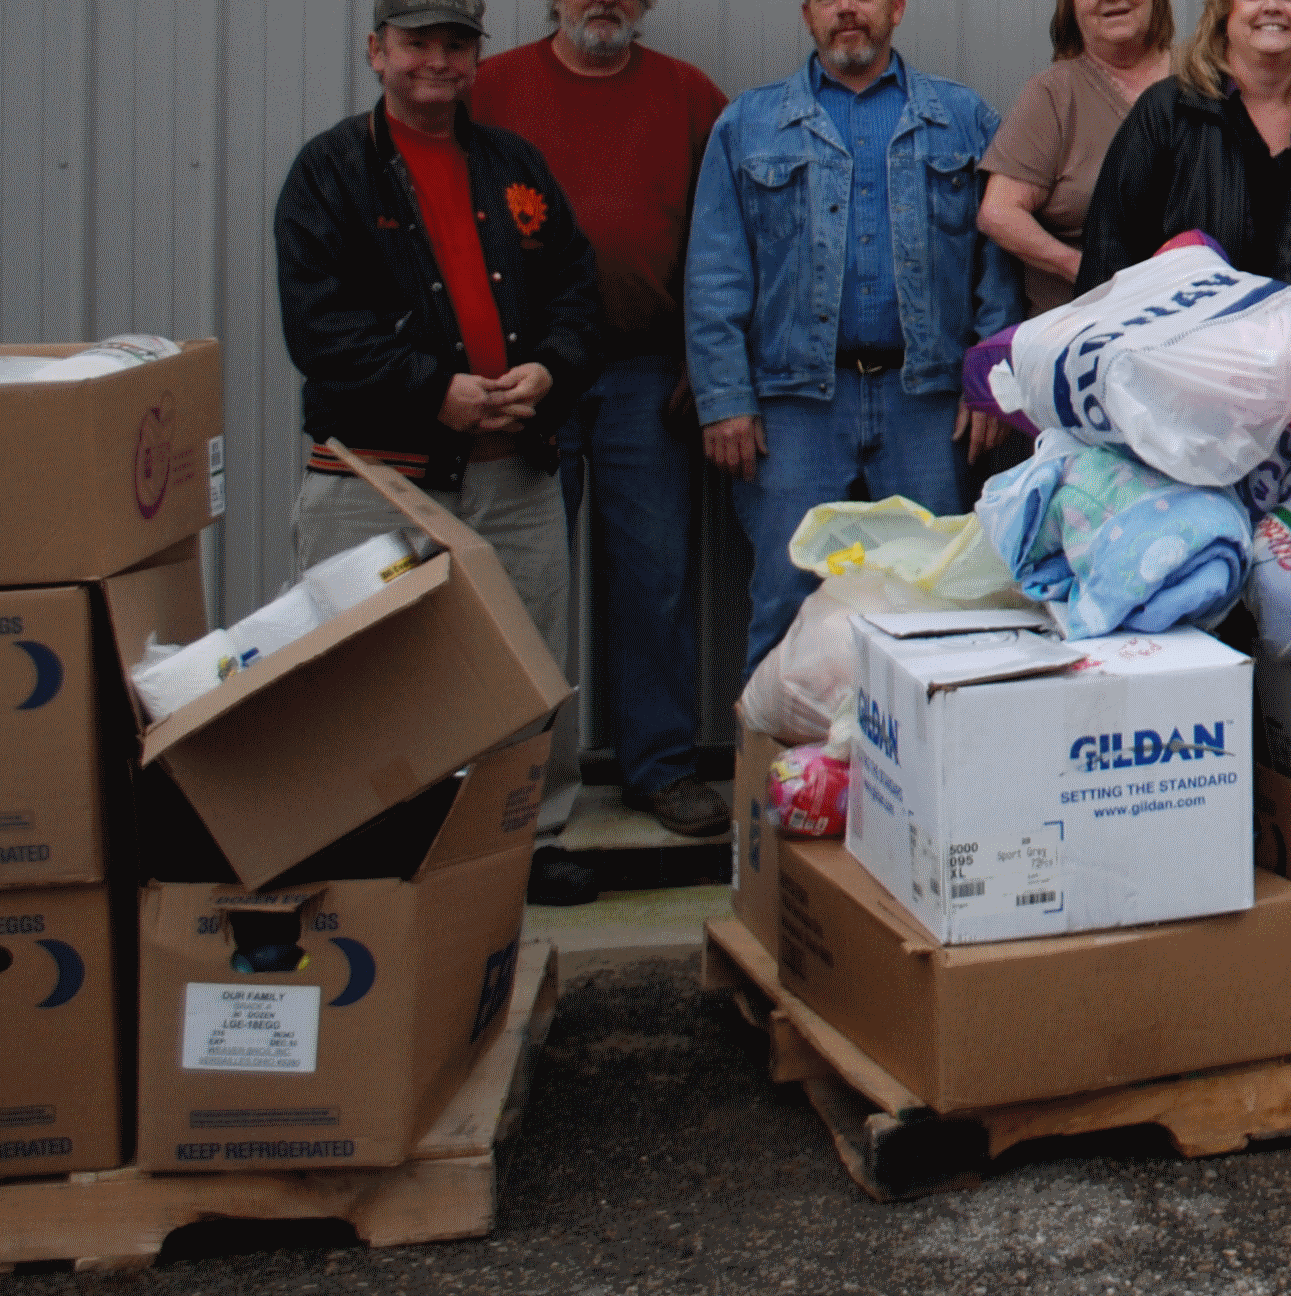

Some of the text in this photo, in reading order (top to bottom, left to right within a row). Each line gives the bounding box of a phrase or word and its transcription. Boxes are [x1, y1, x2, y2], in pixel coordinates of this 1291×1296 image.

[1069, 721, 1226, 773] GILDAN
[1060, 771, 1238, 805] SETTING THE STANDARD
[1094, 794, 1206, 818] www.gildan.com
[222, 991, 287, 1002] OUR FAMILY
[177, 1140, 354, 1162] KEEP REFRIGERATED
